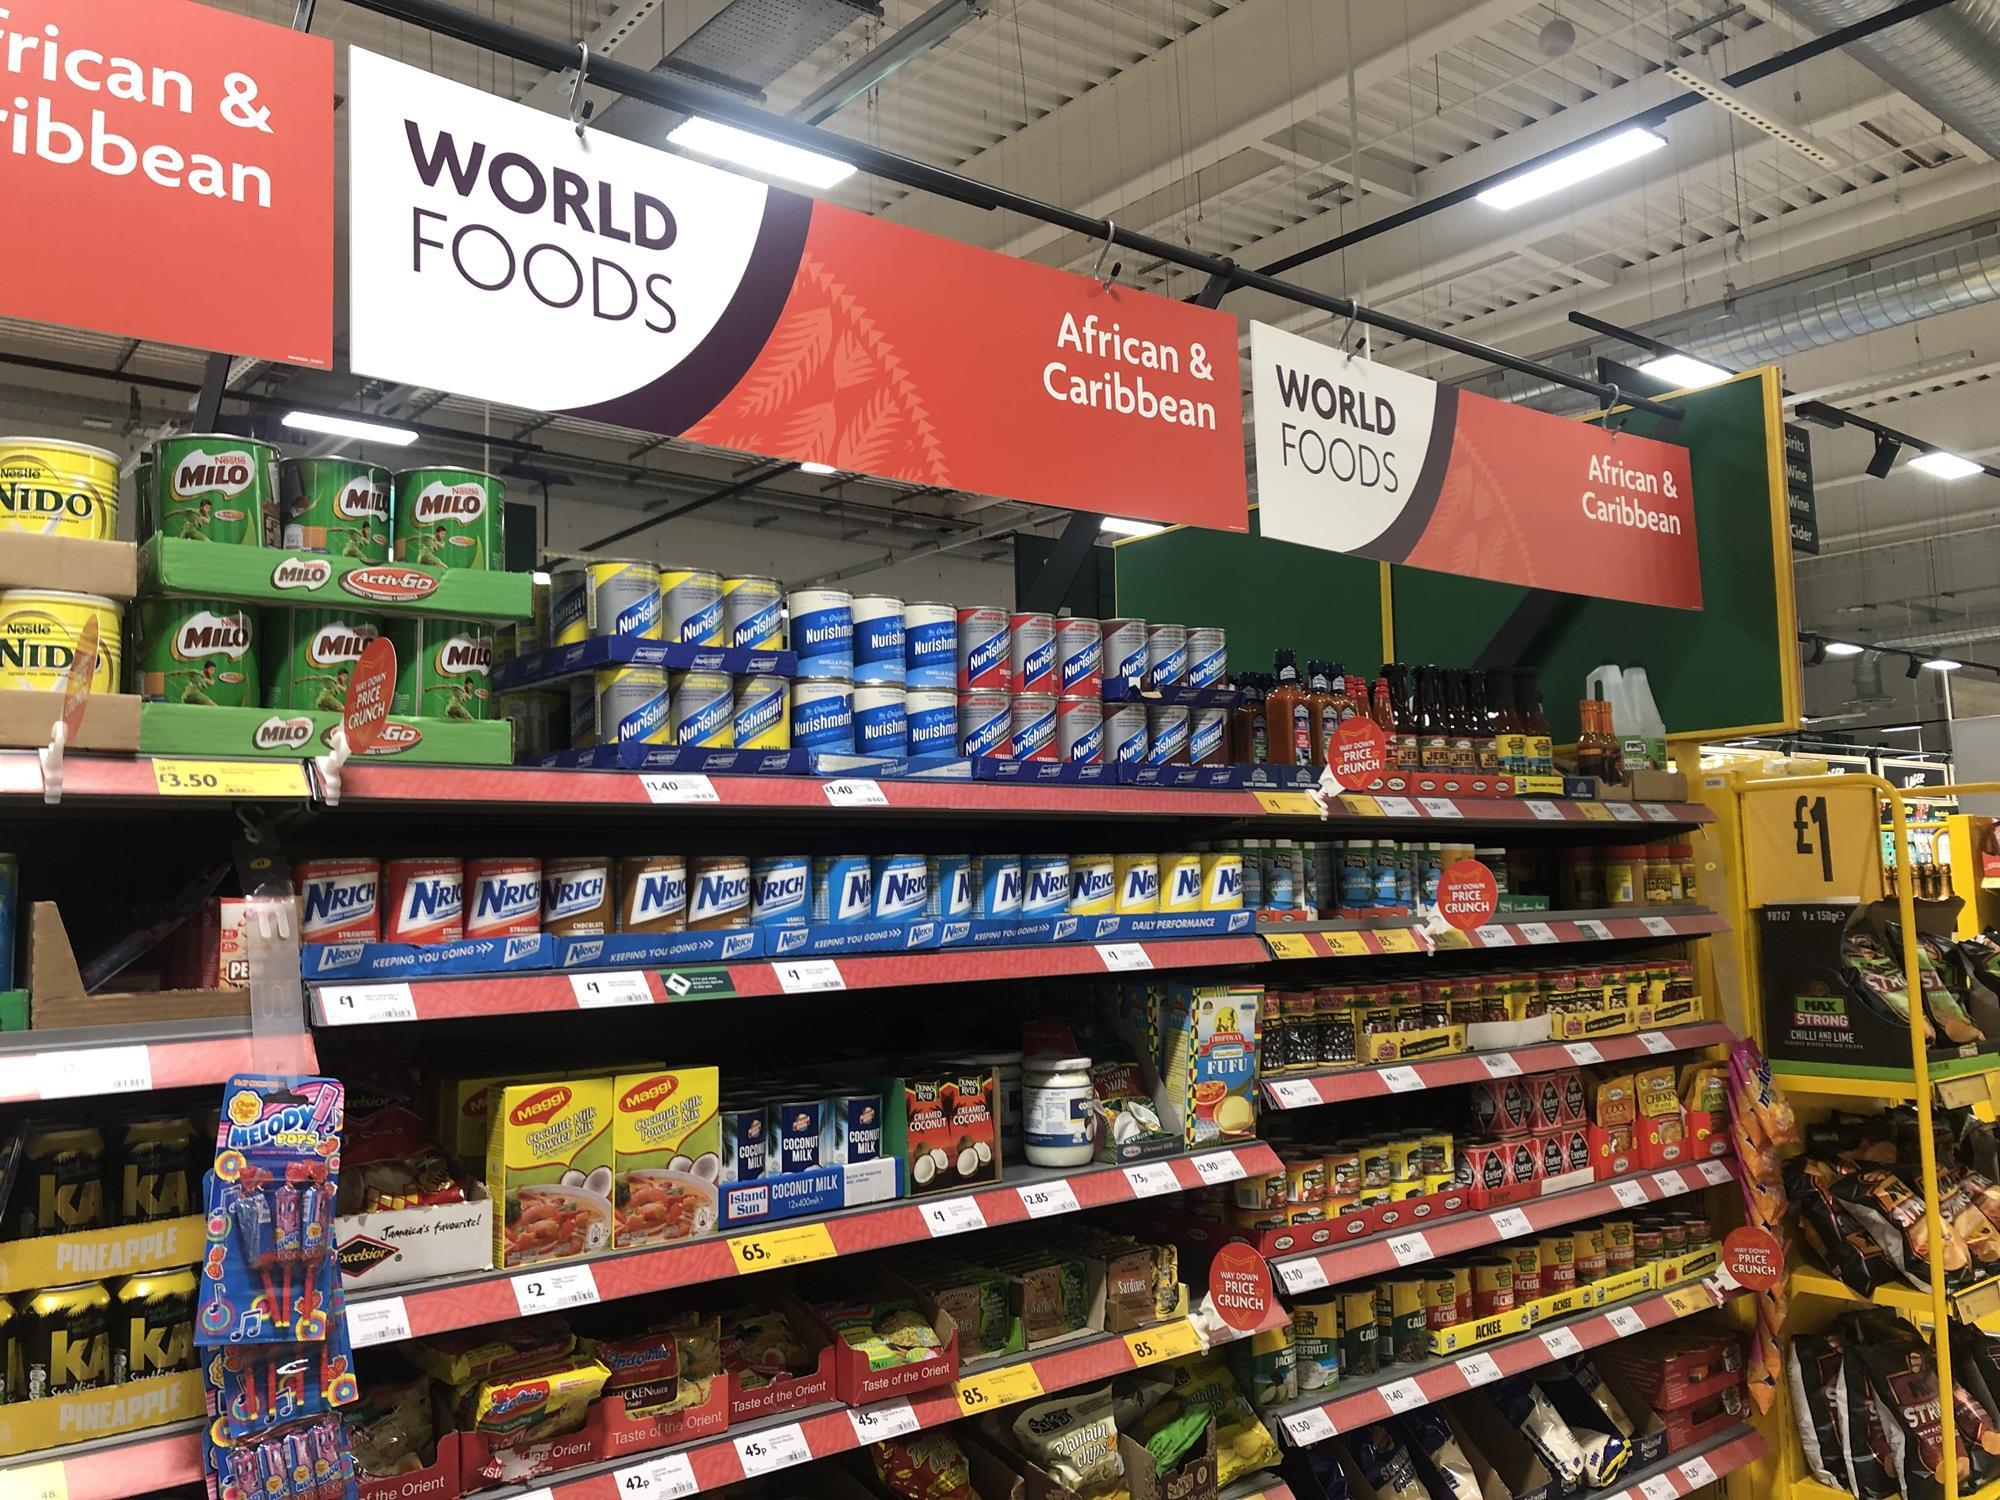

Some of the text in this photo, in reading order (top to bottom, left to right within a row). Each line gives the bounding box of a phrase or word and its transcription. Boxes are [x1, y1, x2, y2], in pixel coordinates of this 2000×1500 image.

[220, 73, 273, 133] &
[404, 119, 677, 250] WORLD
[412, 207, 676, 334] FOODS
[1057, 312, 1214, 380] African &
[1043, 361, 1216, 429] Caribbean
[1276, 365, 1395, 436] WORLD
[1784, 433, 1804, 452] pirits
[1283, 423, 1398, 493] FOODS
[180, 465, 248, 488] MILO
[1588, 455, 1678, 498] African &
[1788, 464, 1807, 482] Wine
[0, 483, 92, 516] NIDO
[419, 495, 481, 516] MILO
[1789, 495, 1810, 512] Wine
[1582, 491, 1681, 535] Caribbean
[1791, 524, 1812, 542] Cider
[278, 567, 326, 582] MILO
[184, 625, 248, 649] MILO
[447, 646, 492, 666] MILO
[367, 672, 387, 688] DOWN
[356, 687, 380, 709] PRICE
[349, 703, 385, 729] CRUNCH
[795, 712, 852, 737] Nurishment
[261, 726, 307, 741] MILO
[1339, 740, 1375, 752] WAY DOWN
[1344, 750, 1372, 762] PRICE
[1337, 760, 1380, 775] CRUNCH
[160, 774, 217, 788] £3.50
[647, 781, 678, 792] £1.40
[825, 785, 852, 796] £1.40
[1793, 795, 1833, 882] £1
[542, 878, 603, 911] NRICH
[1462, 882, 1485, 890] DOWN
[305, 881, 375, 923] NRICH
[478, 878, 540, 918] NRICH
[1452, 891, 1481, 901] PRICE
[1445, 902, 1490, 913] CRUNCH
[1132, 918, 1215, 930] DAILY PERFORMANCE
[815, 930, 888, 949] KEEPING YOU GOING
[975, 925, 1038, 941] KEEPING YOU GOING
[372, 938, 539, 969] KEEPING YOU GOING NRICH
[610, 943, 698, 963] KEEPING YOU GOING
[1108, 950, 1118, 960] £1
[788, 969, 800, 981] £1
[587, 982, 600, 993] £1
[340, 996, 354, 1008] £1
[1803, 999, 1838, 1013] MAX
[1796, 1013, 1848, 1027] STRONG
[1211, 1032, 1242, 1043] TROPIWAY
[1791, 1030, 1817, 1040] CHILLI
[1834, 1032, 1854, 1043] LIME
[1207, 1057, 1248, 1075] FUFU
[625, 1079, 672, 1108] Maggi
[918, 1091, 933, 1101] RIVER
[962, 1085, 978, 1096] RIVER
[517, 1091, 566, 1122] Maggi
[634, 1095, 702, 1132] Coconut Milk
[957, 1105, 986, 1116] CREAMED
[914, 1110, 942, 1121] CREAMED
[953, 1111, 990, 1126] COCONUT
[231, 1107, 315, 1146] MELODY
[526, 1106, 597, 1145] Coconut Milk
[640, 1109, 700, 1141] Powder Mix
[909, 1118, 947, 1132] COCONUT
[276, 1133, 316, 1144] POPS
[532, 1130, 573, 1155] Powder
[575, 1121, 594, 1139] Mix
[783, 1135, 818, 1150] COCONUT
[849, 1128, 880, 1143] COCONUT
[792, 1149, 812, 1162] MILK
[858, 1141, 875, 1154] MILK
[748, 1156, 762, 1170] MILK
[1197, 1161, 1219, 1173] £2.90
[1515, 1162, 1532, 1173] Exeter
[1131, 1173, 1148, 1184] 75p
[123, 1165, 188, 1216] KA
[772, 1179, 814, 1200] COCONUT
[816, 1175, 838, 1191] MILK
[38, 1175, 101, 1228] KA
[730, 1188, 766, 1205] Island
[1024, 1192, 1049, 1205] £2.85
[736, 1202, 760, 1216] Sun
[933, 1211, 946, 1222] £1
[381, 1214, 482, 1241] Jamaica's favourite!
[57, 1228, 177, 1272] PINEAPPLE
[742, 1243, 771, 1262] 65p
[1394, 1242, 1410, 1254] £1.10
[1734, 1247, 1748, 1255] WAY
[1738, 1254, 1767, 1265] PRICE
[1220, 1271, 1259, 1282] WAY DOWN
[1284, 1269, 1303, 1282] £1.10
[1733, 1263, 1776, 1276] CRUNCH
[528, 1282, 545, 1297] £2
[1118, 1278, 1146, 1294] Sardines
[1225, 1281, 1255, 1296] PRICE
[1218, 1295, 1264, 1311] CRUNCH
[1475, 1319, 1502, 1340] ACKEE
[130, 1318, 195, 1370] KA
[1134, 1341, 1157, 1358] 85p
[51, 1330, 110, 1385] KA
[862, 1362, 950, 1393] Taste of the Orient
[732, 1381, 826, 1413] Taste of the Orient
[962, 1387, 988, 1405] 85p
[1385, 1390, 1403, 1401] £1.40
[59, 1381, 181, 1432] PINEAPPLE
[858, 1410, 878, 1427] 45p
[1290, 1420, 1311, 1433] £1.50
[612, 1410, 722, 1445] Taste of the Orient
[1053, 1422, 1107, 1456] Plantain
[552, 1441, 591, 1459] Orient
[745, 1440, 767, 1457] 45p
[1076, 1442, 1107, 1469] chips
[376, 1476, 445, 1500] the Orient
[625, 1475, 650, 1490] 42p
